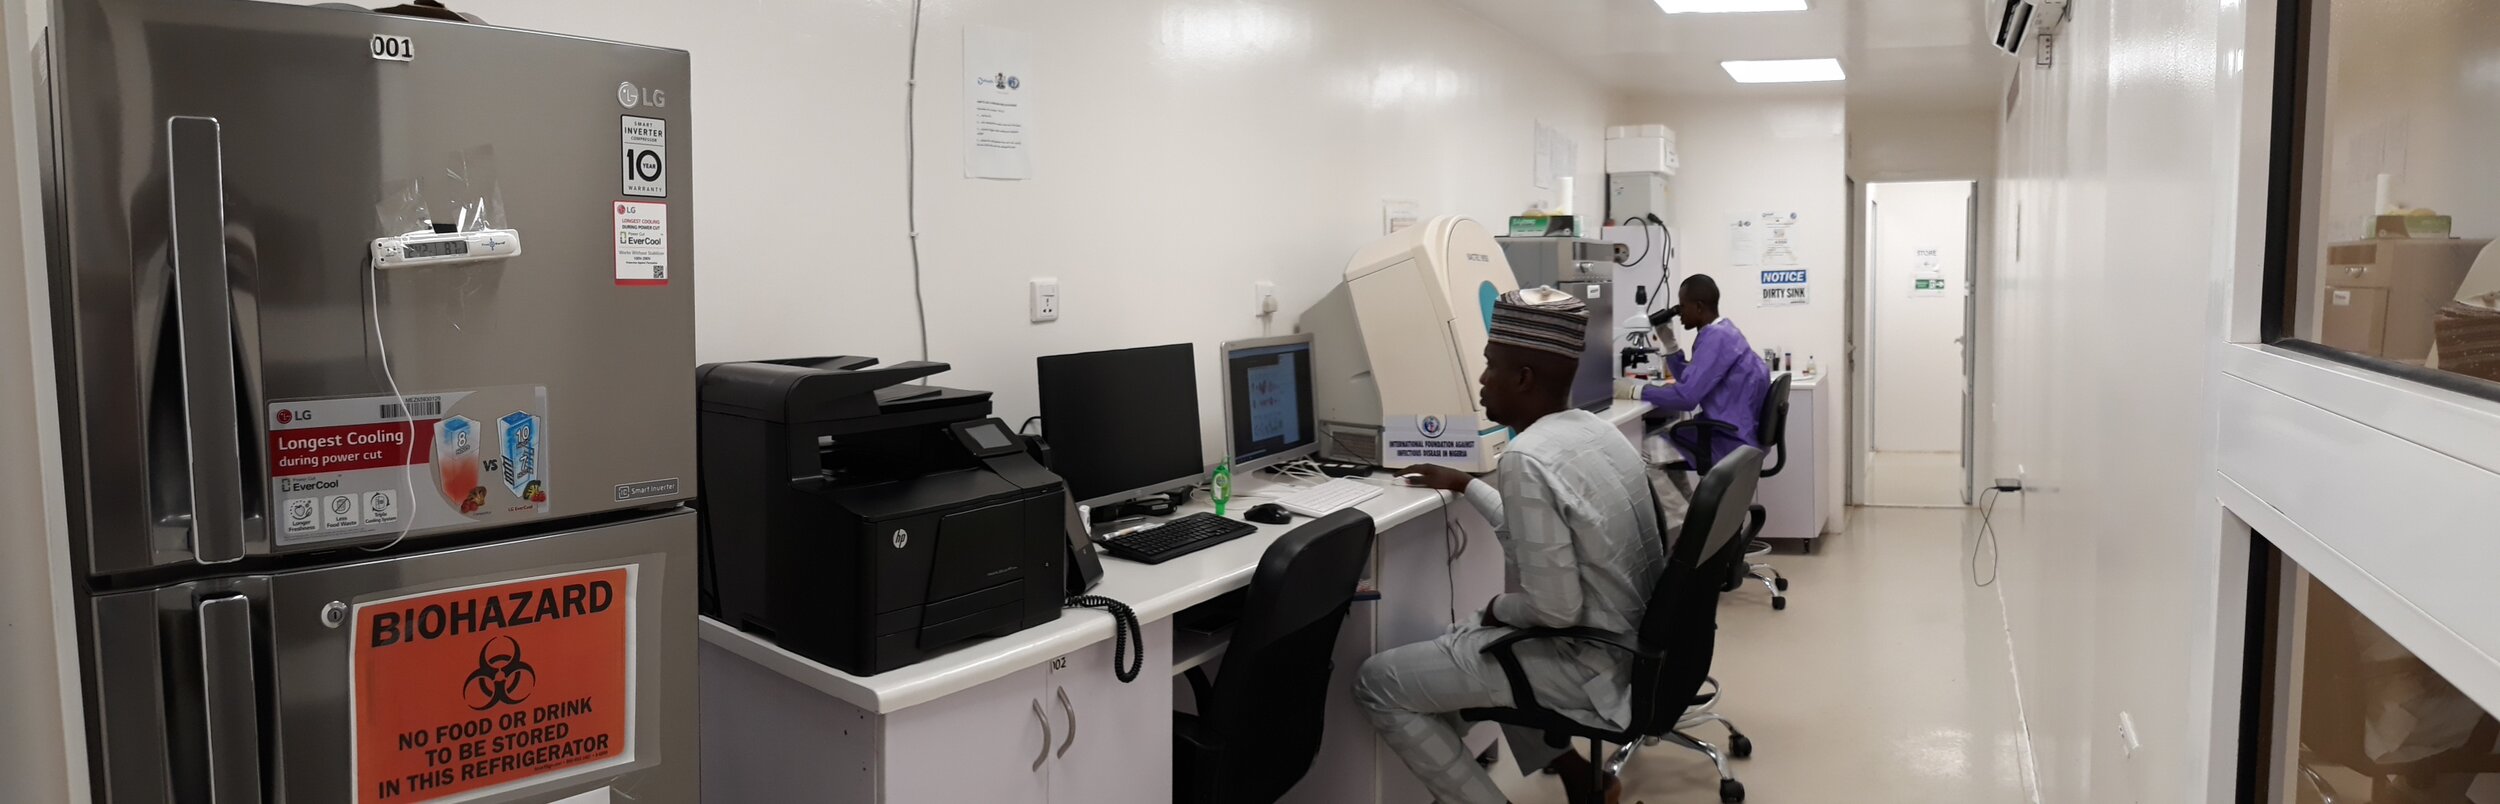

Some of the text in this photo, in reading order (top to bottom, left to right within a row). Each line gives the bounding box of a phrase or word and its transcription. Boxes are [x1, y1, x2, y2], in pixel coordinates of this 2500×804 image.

[373, 36, 412, 57] 001
[642, 88, 665, 107] LG
[624, 127, 663, 137] INVERTER
[626, 149, 662, 182] 10
[628, 237, 661, 245] EverCool
[1763, 271, 1804, 282] NOTICE
[1763, 288, 1805, 299] DIRTY SINK
[294, 410, 312, 421] LG
[279, 430, 404, 452] Longest Cooling
[458, 432, 467, 447] 8
[516, 425, 530, 442] 10
[279, 450, 382, 468] during power cut
[293, 480, 339, 492] EverCool
[893, 529, 908, 549] hp
[372, 580, 613, 648] BIOHAZARD
[399, 696, 593, 751] NO FOOD OR DRINK
[425, 722, 569, 768] TO BE STORED
[378, 779, 400, 800] IN
[406, 767, 454, 792] THIS
[461, 733, 609, 782] REFRIGERATOR
